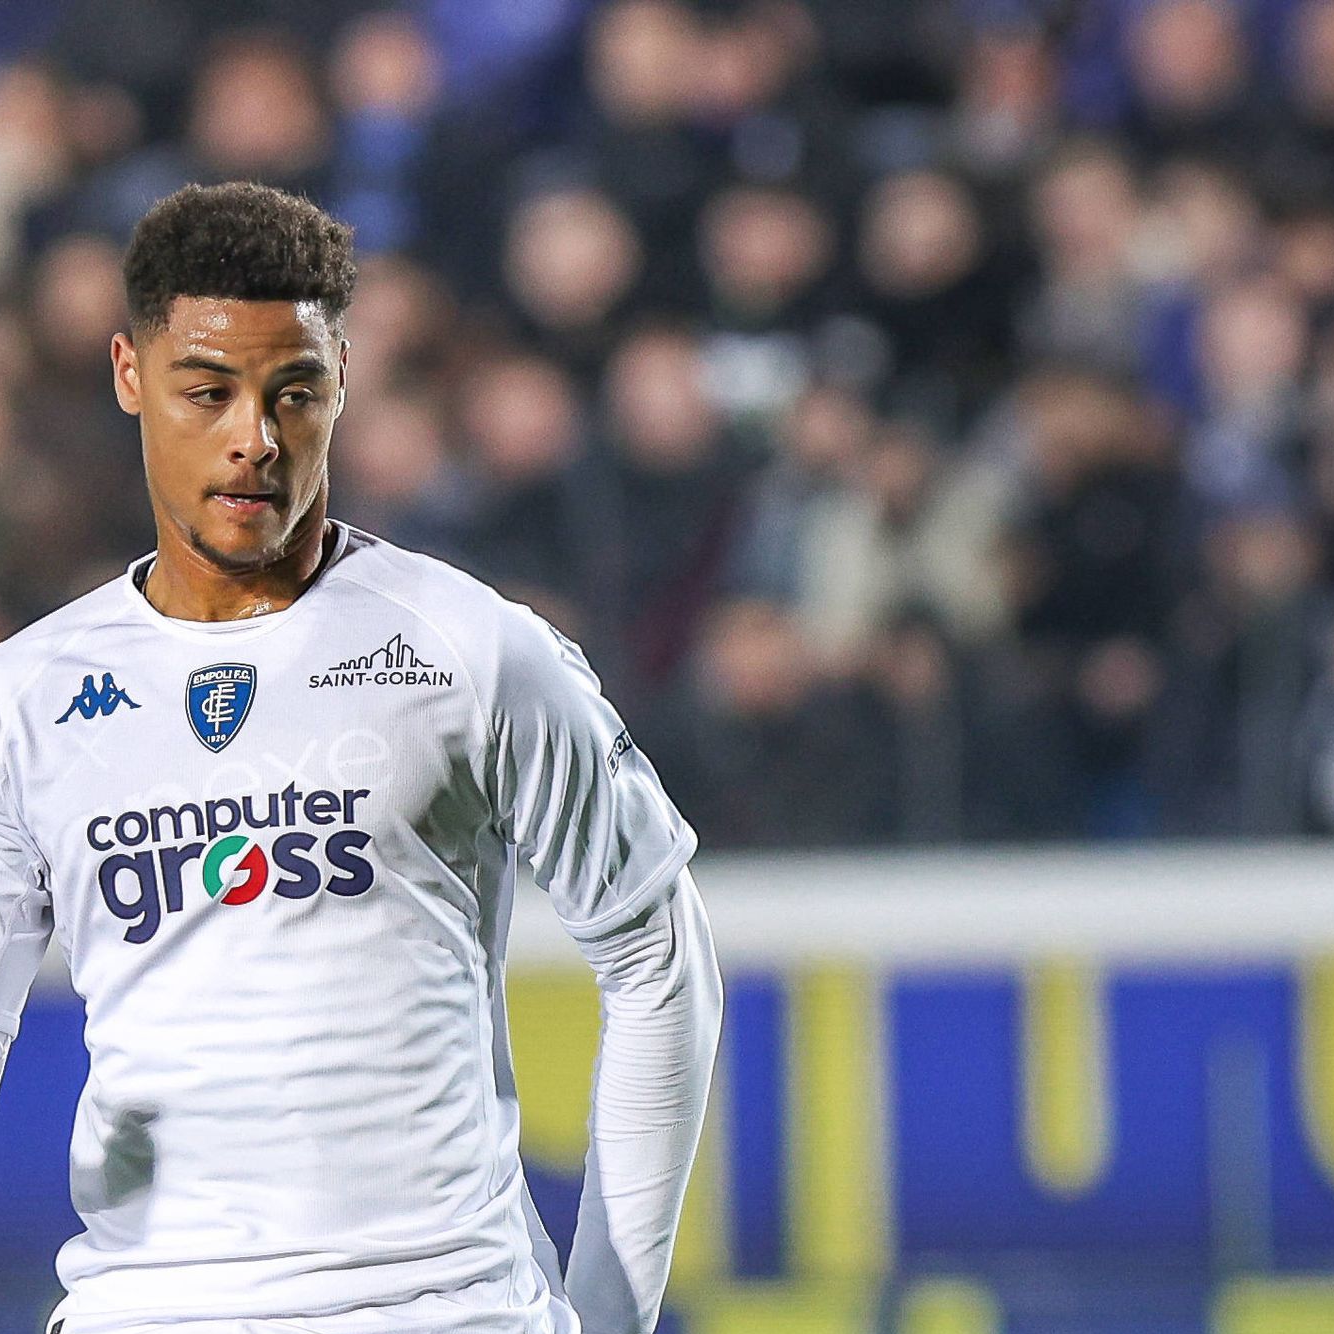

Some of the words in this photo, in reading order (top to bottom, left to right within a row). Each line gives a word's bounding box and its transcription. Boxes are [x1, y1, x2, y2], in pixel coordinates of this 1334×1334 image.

[193, 669, 232, 685] EMPOLI
[308, 671, 454, 688] SAINT-GOBAIN
[86, 780, 371, 852] computer
[98, 829, 375, 944] gross
